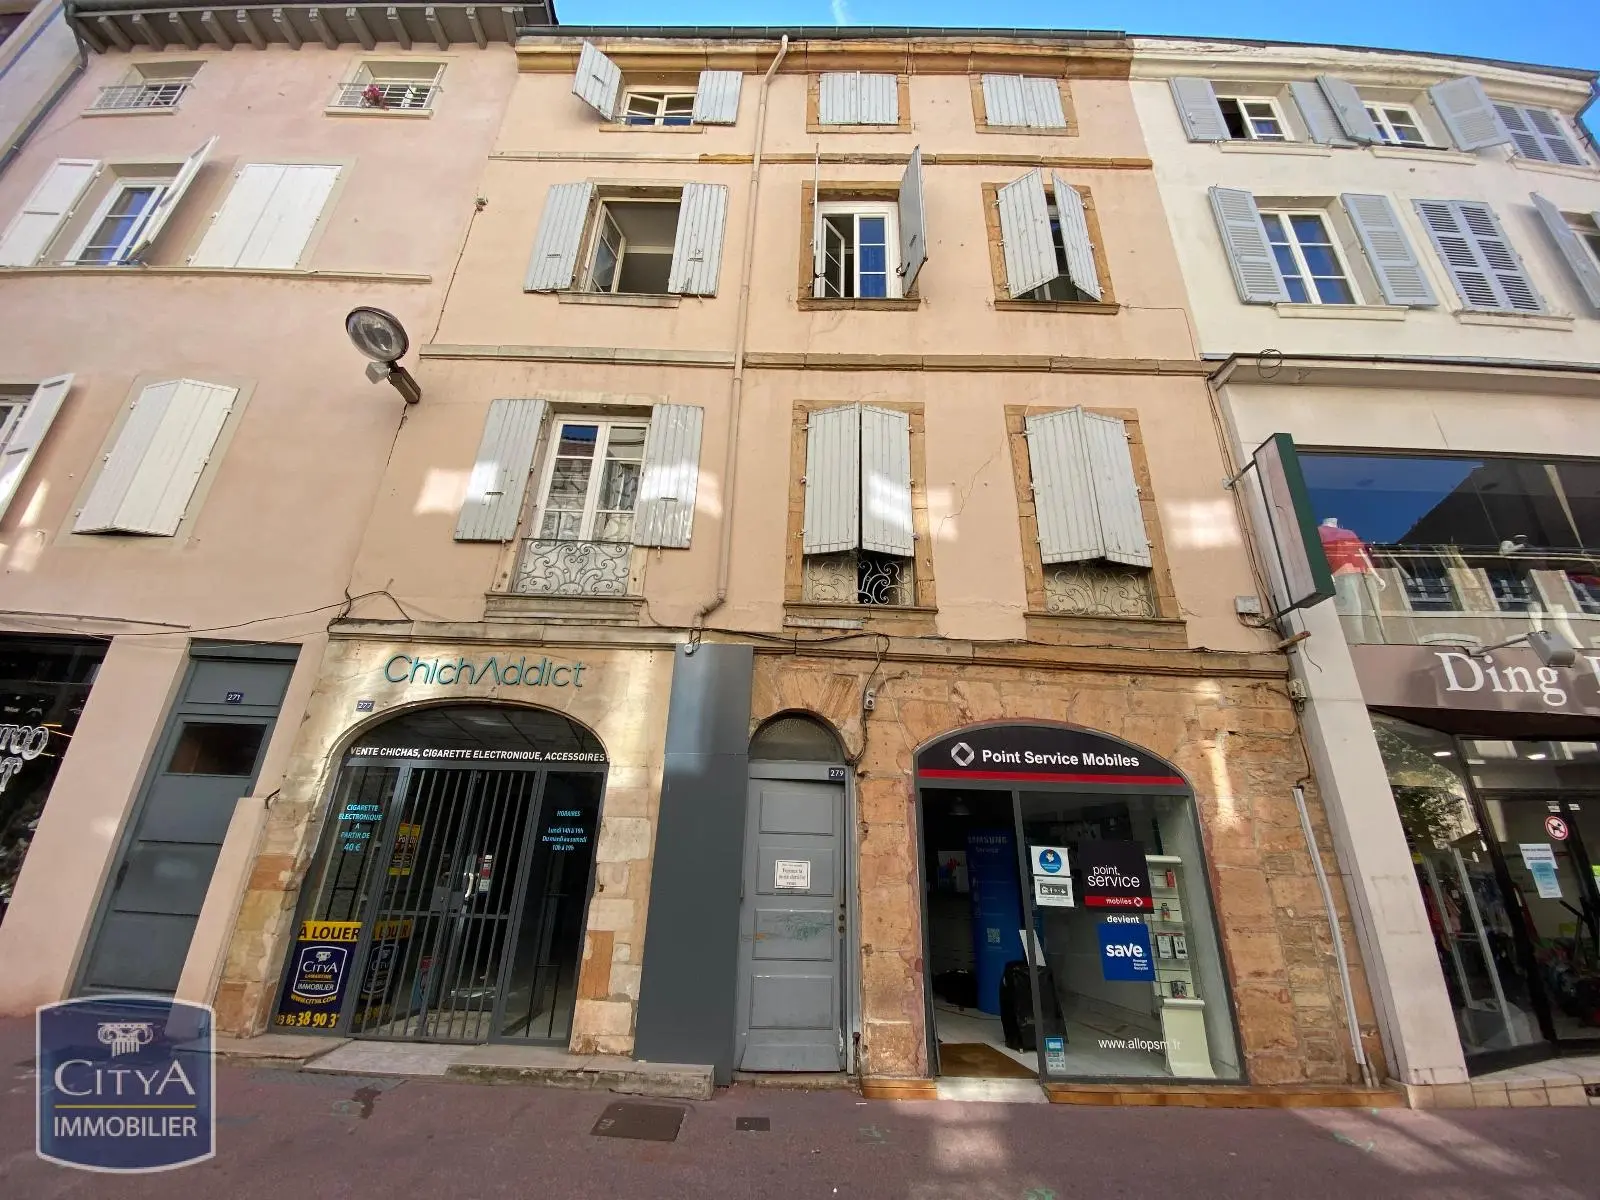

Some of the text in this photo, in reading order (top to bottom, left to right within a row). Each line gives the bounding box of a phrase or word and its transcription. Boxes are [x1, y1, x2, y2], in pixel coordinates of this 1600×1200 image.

[383, 655, 588, 688] ChichAddict
[1434, 652, 1568, 707] Ding
[350, 746, 605, 762] VENTE CHICHAS, CIGARETTE ELECTRONIQUE, ACCESSOIRES
[982, 749, 1140, 767] Point Service Mobiles
[830, 769, 844, 777] 279
[346, 804, 380, 812] CIGARETTE
[338, 813, 383, 821] ELECTRONIQUE
[1087, 873, 1140, 888] service
[1106, 897, 1132, 905] mobiles
[1106, 915, 1140, 923] devient
[311, 926, 361, 940] LOUER
[297, 983, 335, 991] IMMOBILIER
[296, 1011, 312, 1027] 38
[312, 1012, 328, 1027] 90
[328, 1013, 340, 1028] 3
